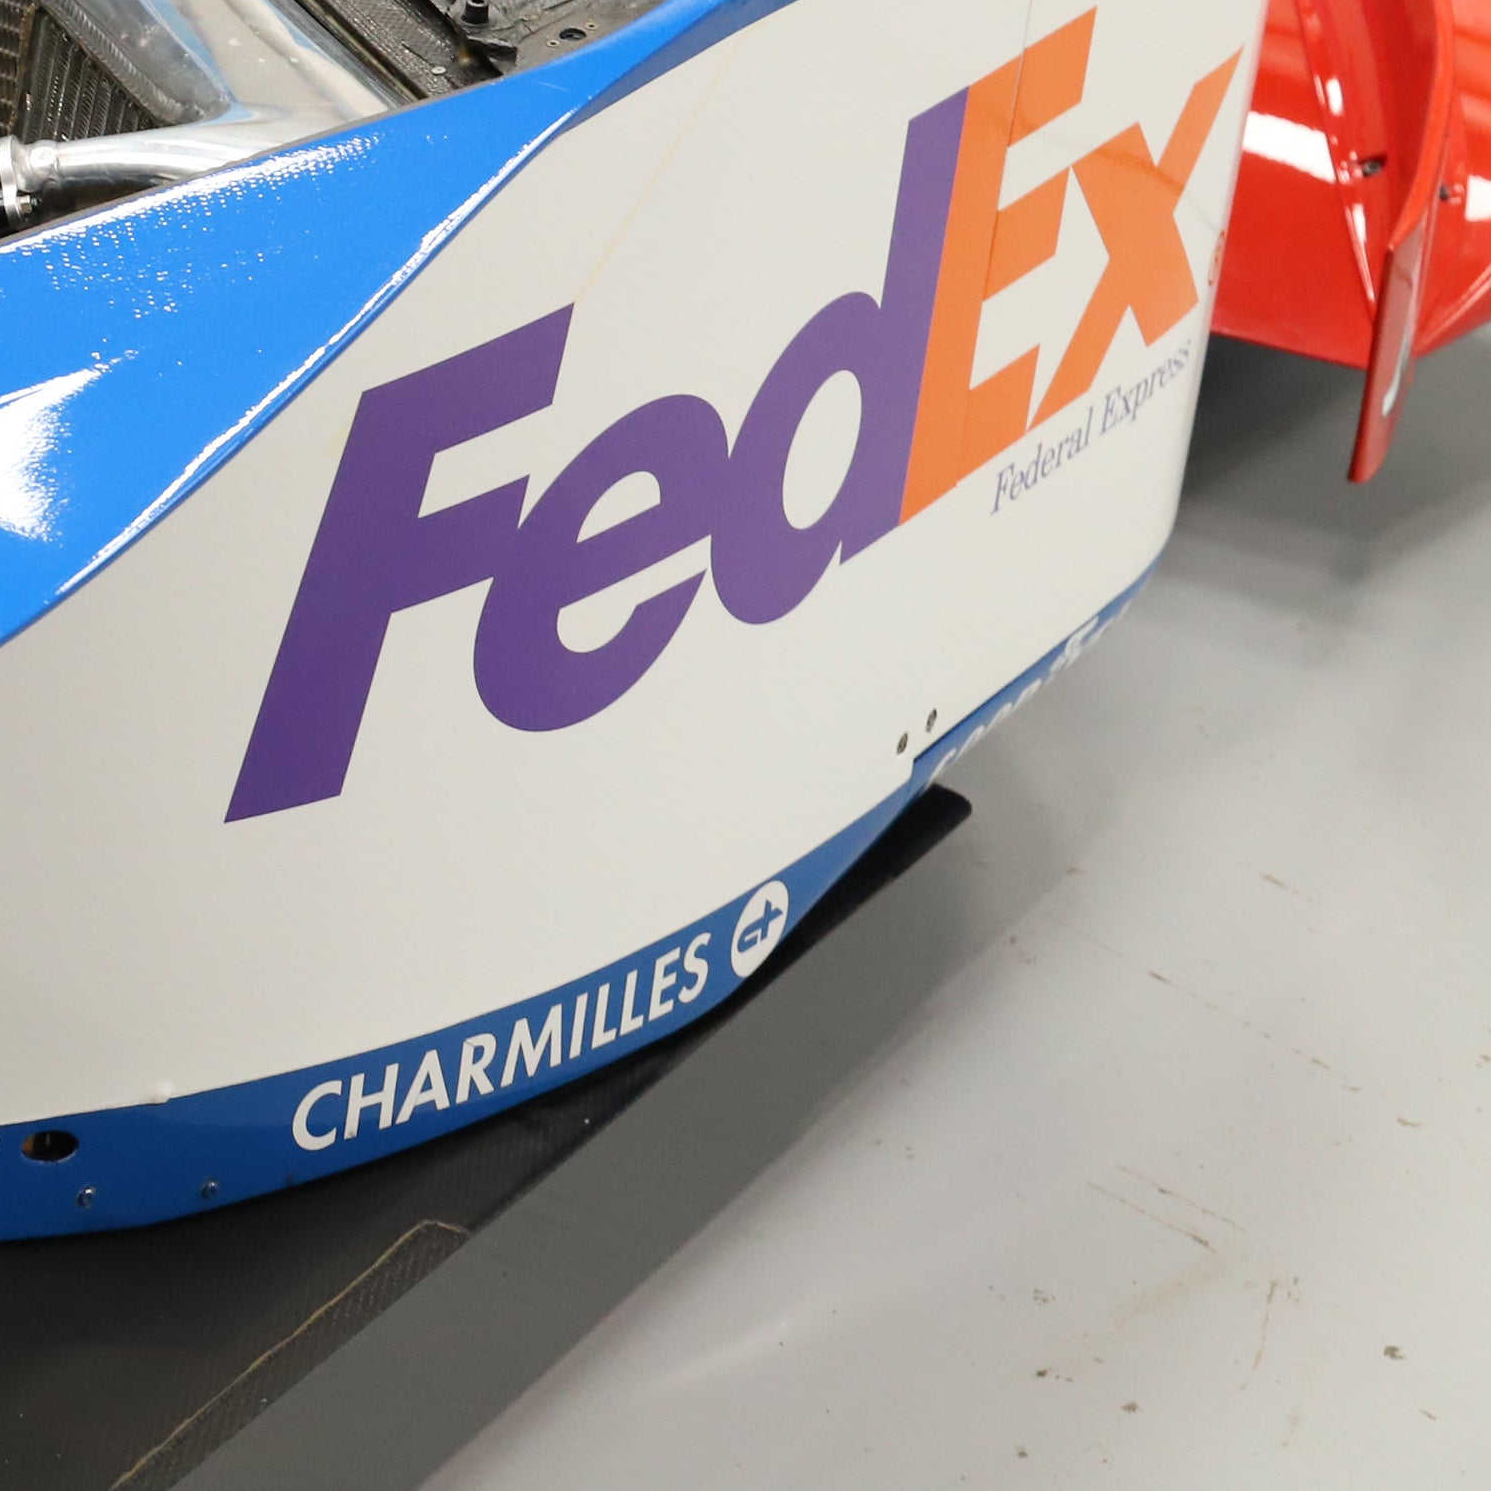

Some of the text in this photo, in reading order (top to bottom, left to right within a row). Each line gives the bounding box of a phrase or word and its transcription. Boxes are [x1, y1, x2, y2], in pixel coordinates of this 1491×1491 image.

[224, 6, 1244, 822] FedEx
[990, 342, 1191, 516] Federal Express
[292, 933, 711, 1151] CHARMILLES
